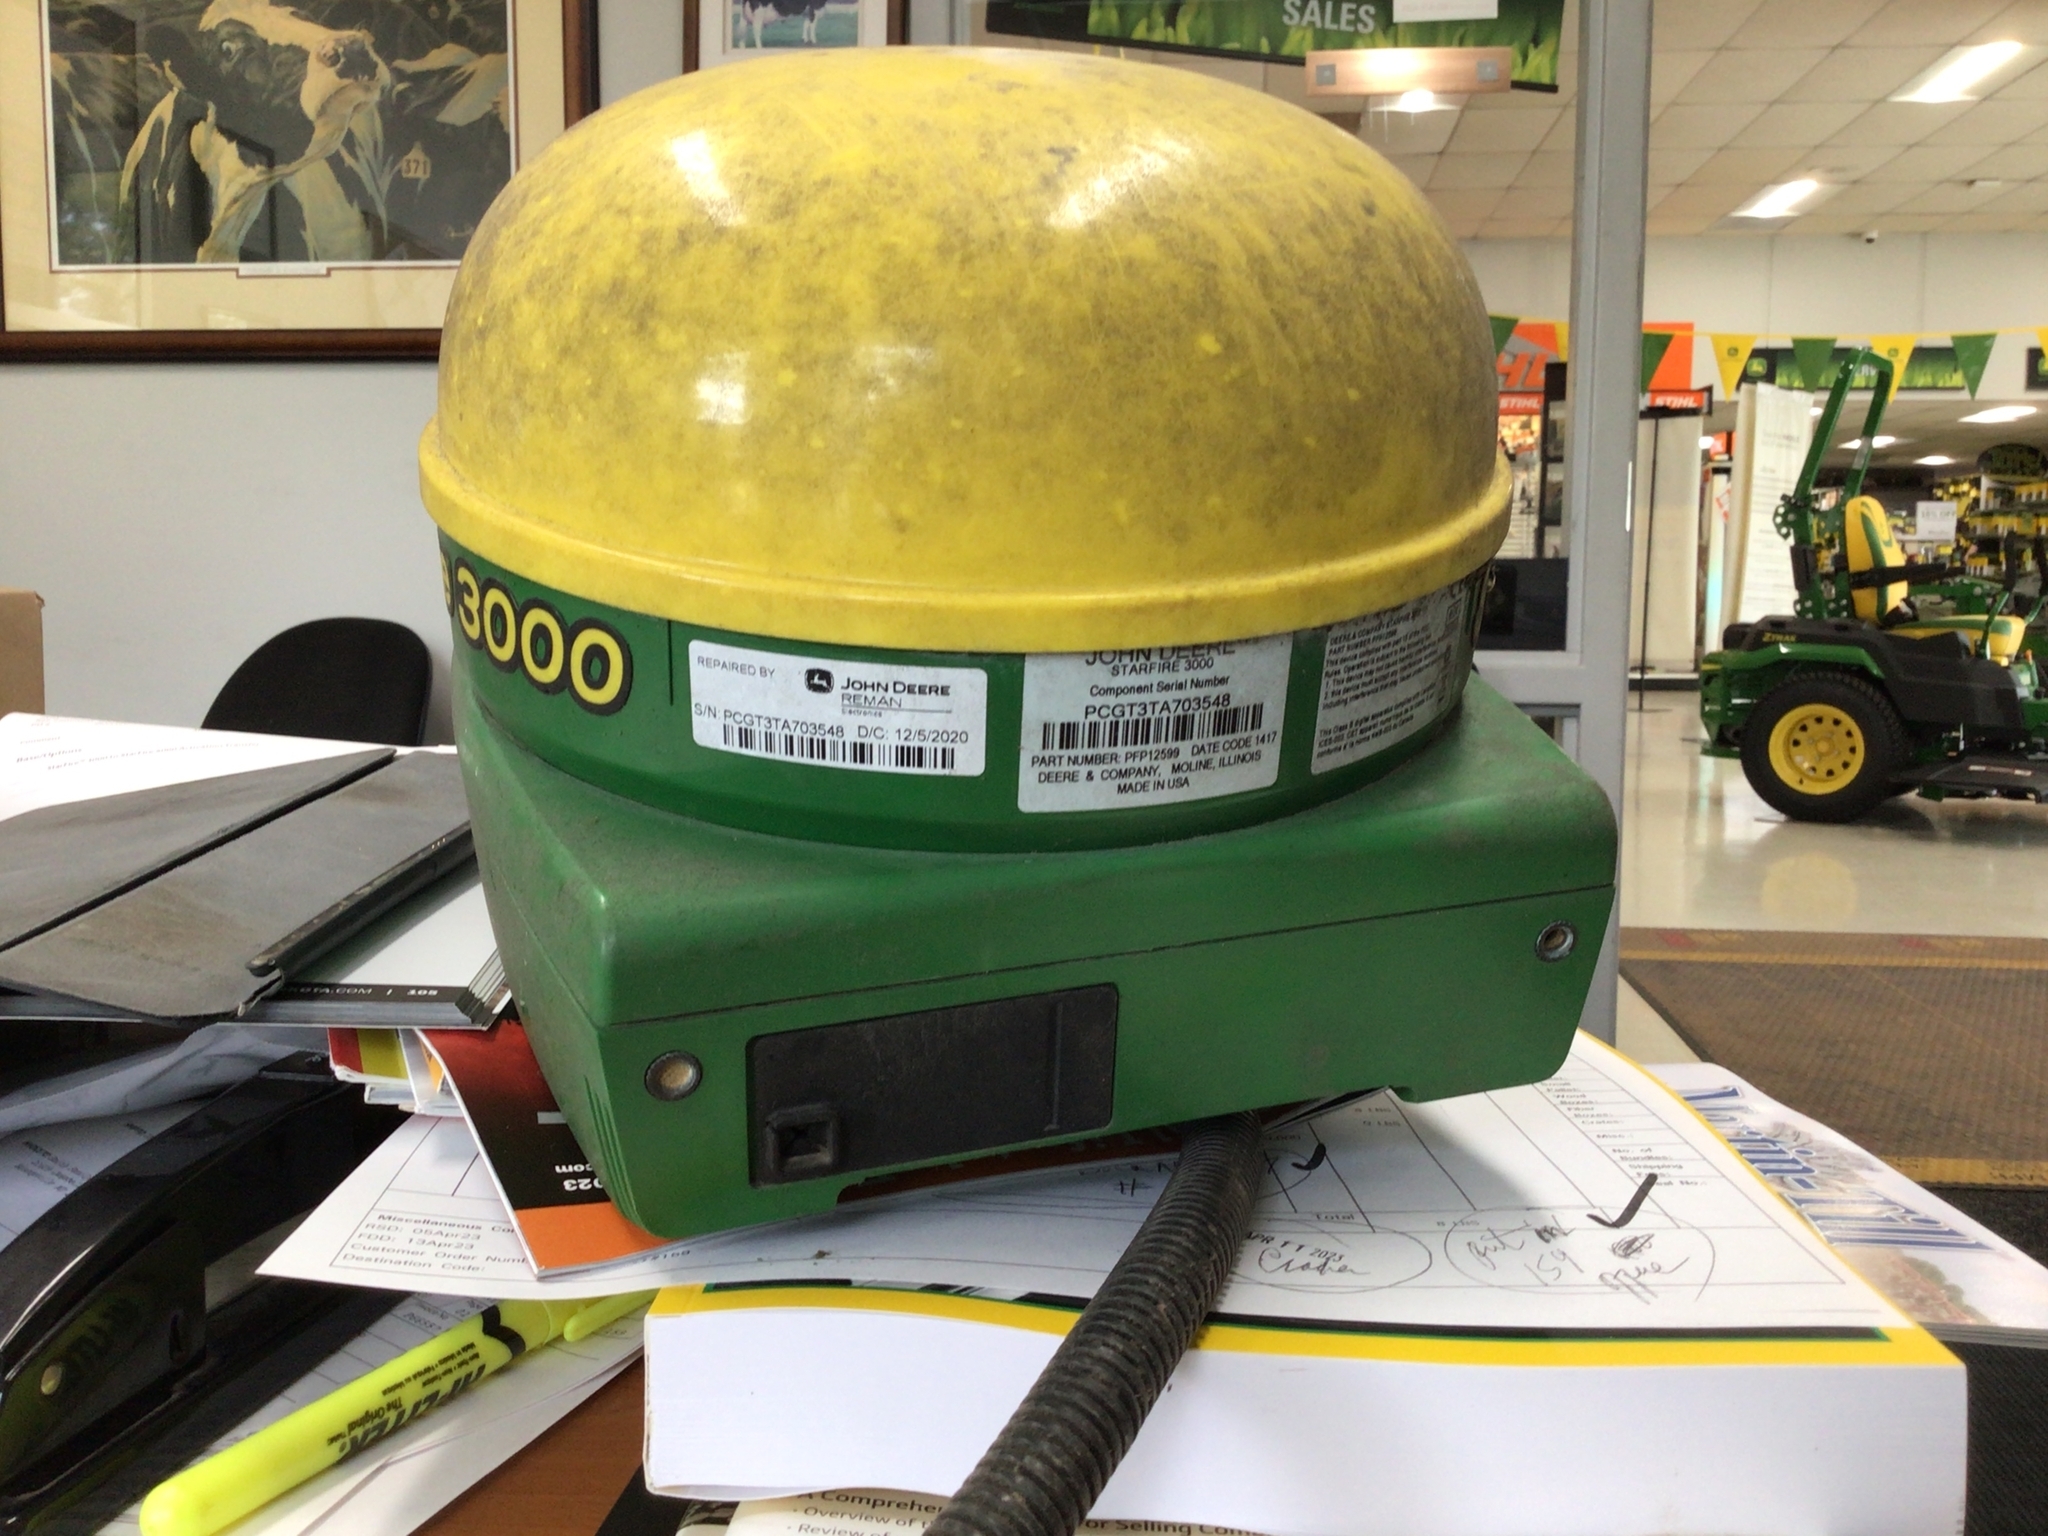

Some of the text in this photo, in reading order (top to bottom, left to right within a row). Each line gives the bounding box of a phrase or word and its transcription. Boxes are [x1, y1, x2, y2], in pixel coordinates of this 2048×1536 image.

[1282, 0, 1377, 35] SALES
[403, 158, 428, 176] 371
[1499, 395, 1541, 409] STIHL
[1655, 396, 1698, 409] STIHL
[455, 559, 633, 716] 3000
[1085, 647, 1151, 667] JOHN
[1111, 657, 1214, 677] STARFIRE 3000
[696, 656, 775, 679] REPAIRED BY
[840, 677, 951, 697] JOHN DEERE
[1090, 675, 1231, 699] Component Serial Number
[840, 693, 903, 709] REMAN
[1084, 693, 1232, 721] PCGT3TA703548
[693, 702, 970, 745] S/N: PCGT3TA703548 D/C: 12/5/2020
[1031, 731, 1278, 769] PART NUMBER: PFP12599 DATE CODE 1417
[1038, 750, 1262, 784] DEERE & COMPANY, MOLINE, ILLINOIS
[1117, 775, 1190, 796] MADE IN USA
[377, 1213, 483, 1232] Miscellaneous
[412, 1227, 482, 1242] 05Apr23
[350, 1243, 427, 1257] Customer
[434, 1250, 478, 1262] Order
[342, 1253, 488, 1274] Destination Code:
[343, 1396, 405, 1436] The Original
[803, 1506, 891, 1525] Overview
[895, 1519, 915, 1528] of
[797, 1523, 866, 1536] Review
[1115, 1519, 1191, 1536] Selling
